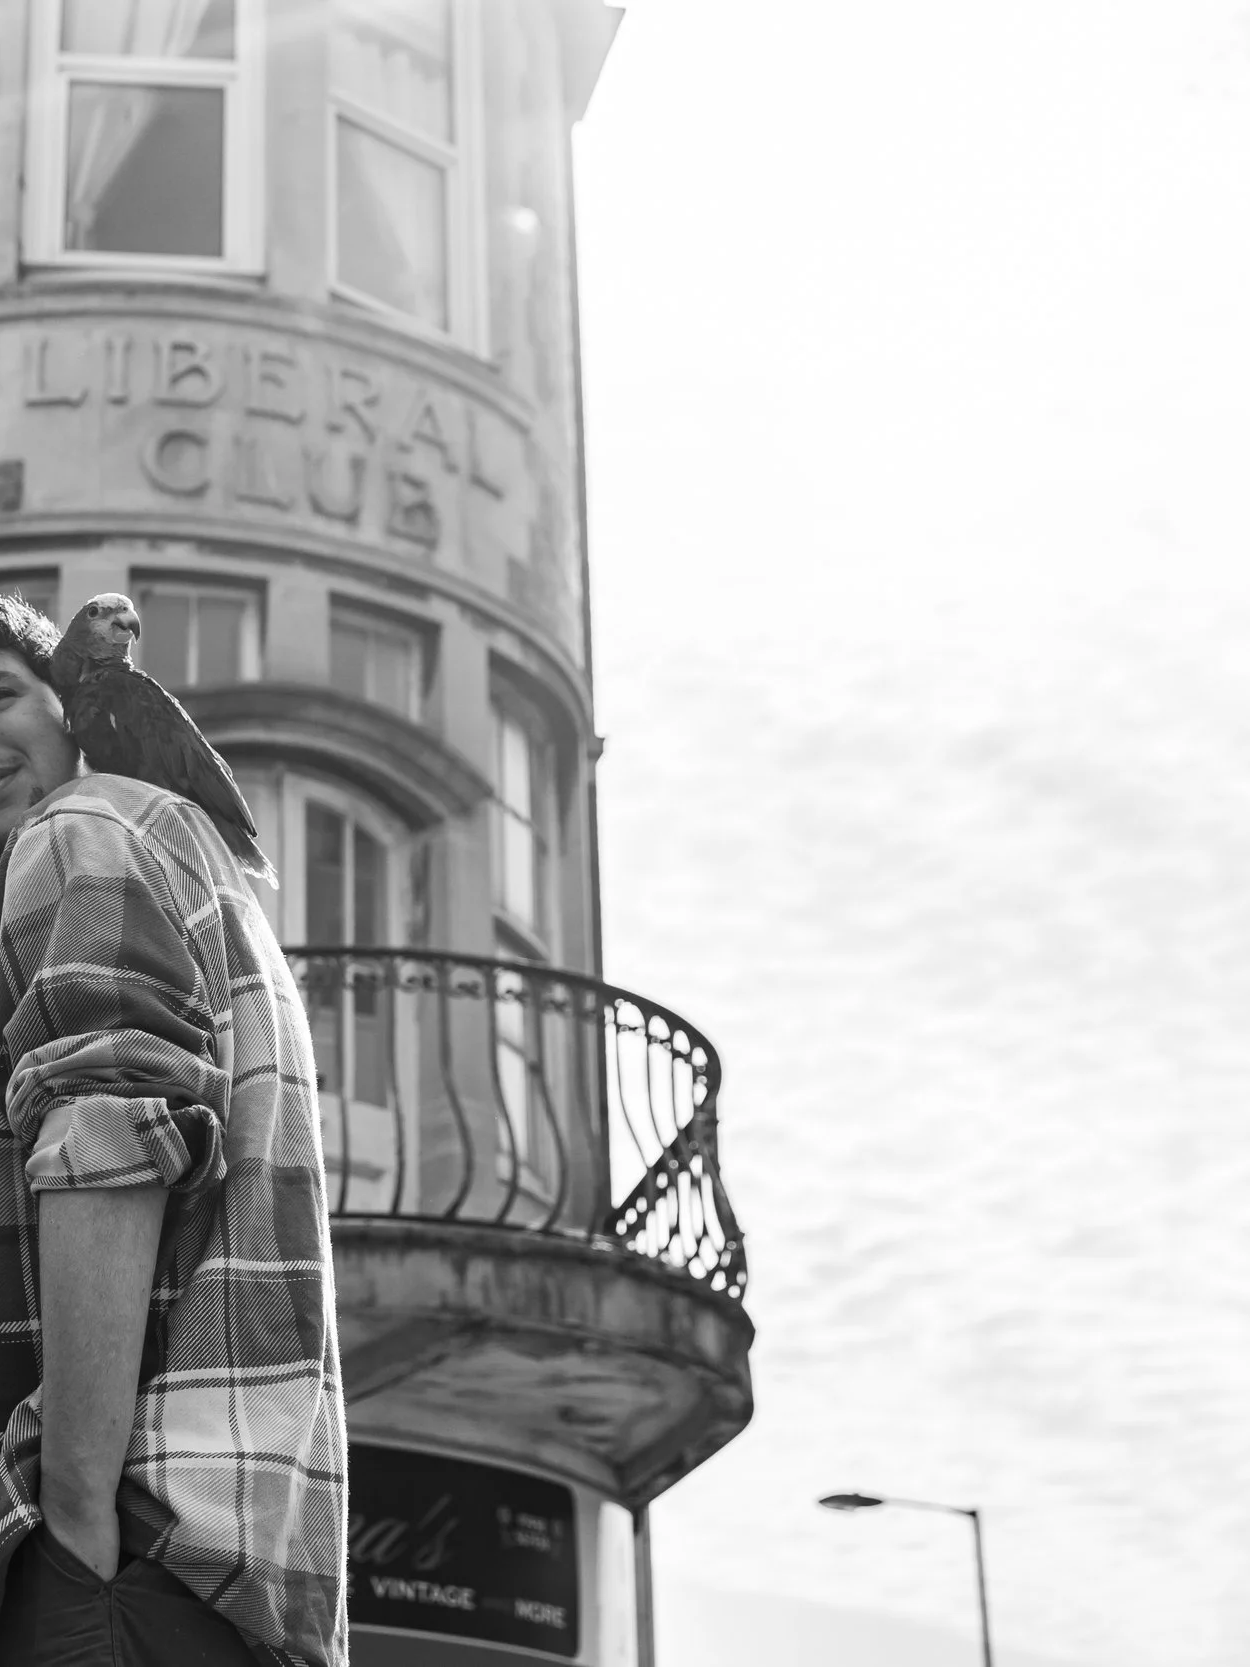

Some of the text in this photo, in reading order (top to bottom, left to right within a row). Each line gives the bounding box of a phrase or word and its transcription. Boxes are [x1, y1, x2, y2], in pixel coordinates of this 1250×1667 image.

[23, 336, 506, 501] LIBERAL
[140, 428, 441, 552] CLUB
[369, 1575, 476, 1611] VINTAGE
[514, 1597, 567, 1630] MORE
